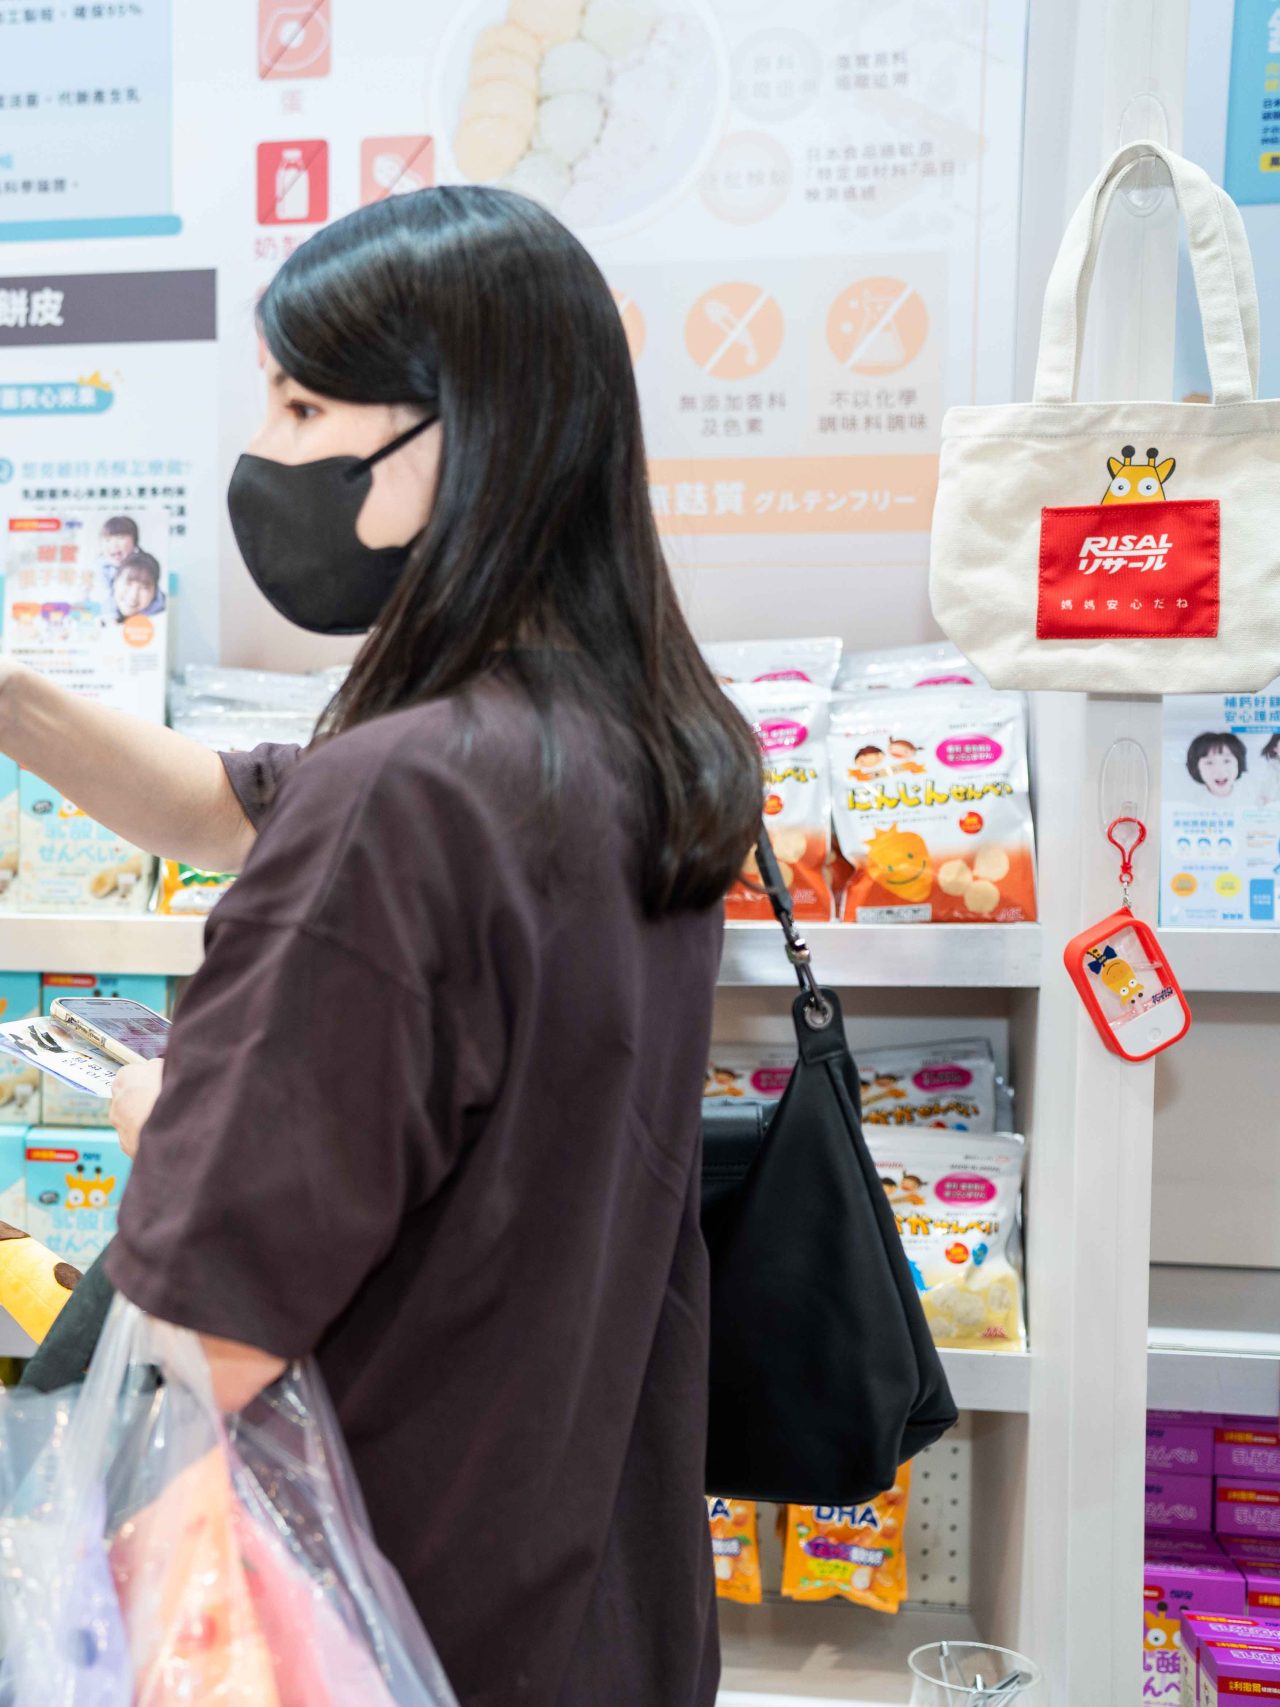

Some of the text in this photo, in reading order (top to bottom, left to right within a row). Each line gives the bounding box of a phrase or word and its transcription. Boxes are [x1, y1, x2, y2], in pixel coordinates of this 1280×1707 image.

[1078, 533, 1173, 558] RISAL
[1078, 556, 1168, 576] リサール
[1061, 597, 1189, 611] 媽媽安心だね
[815, 1503, 880, 1529] DHA
